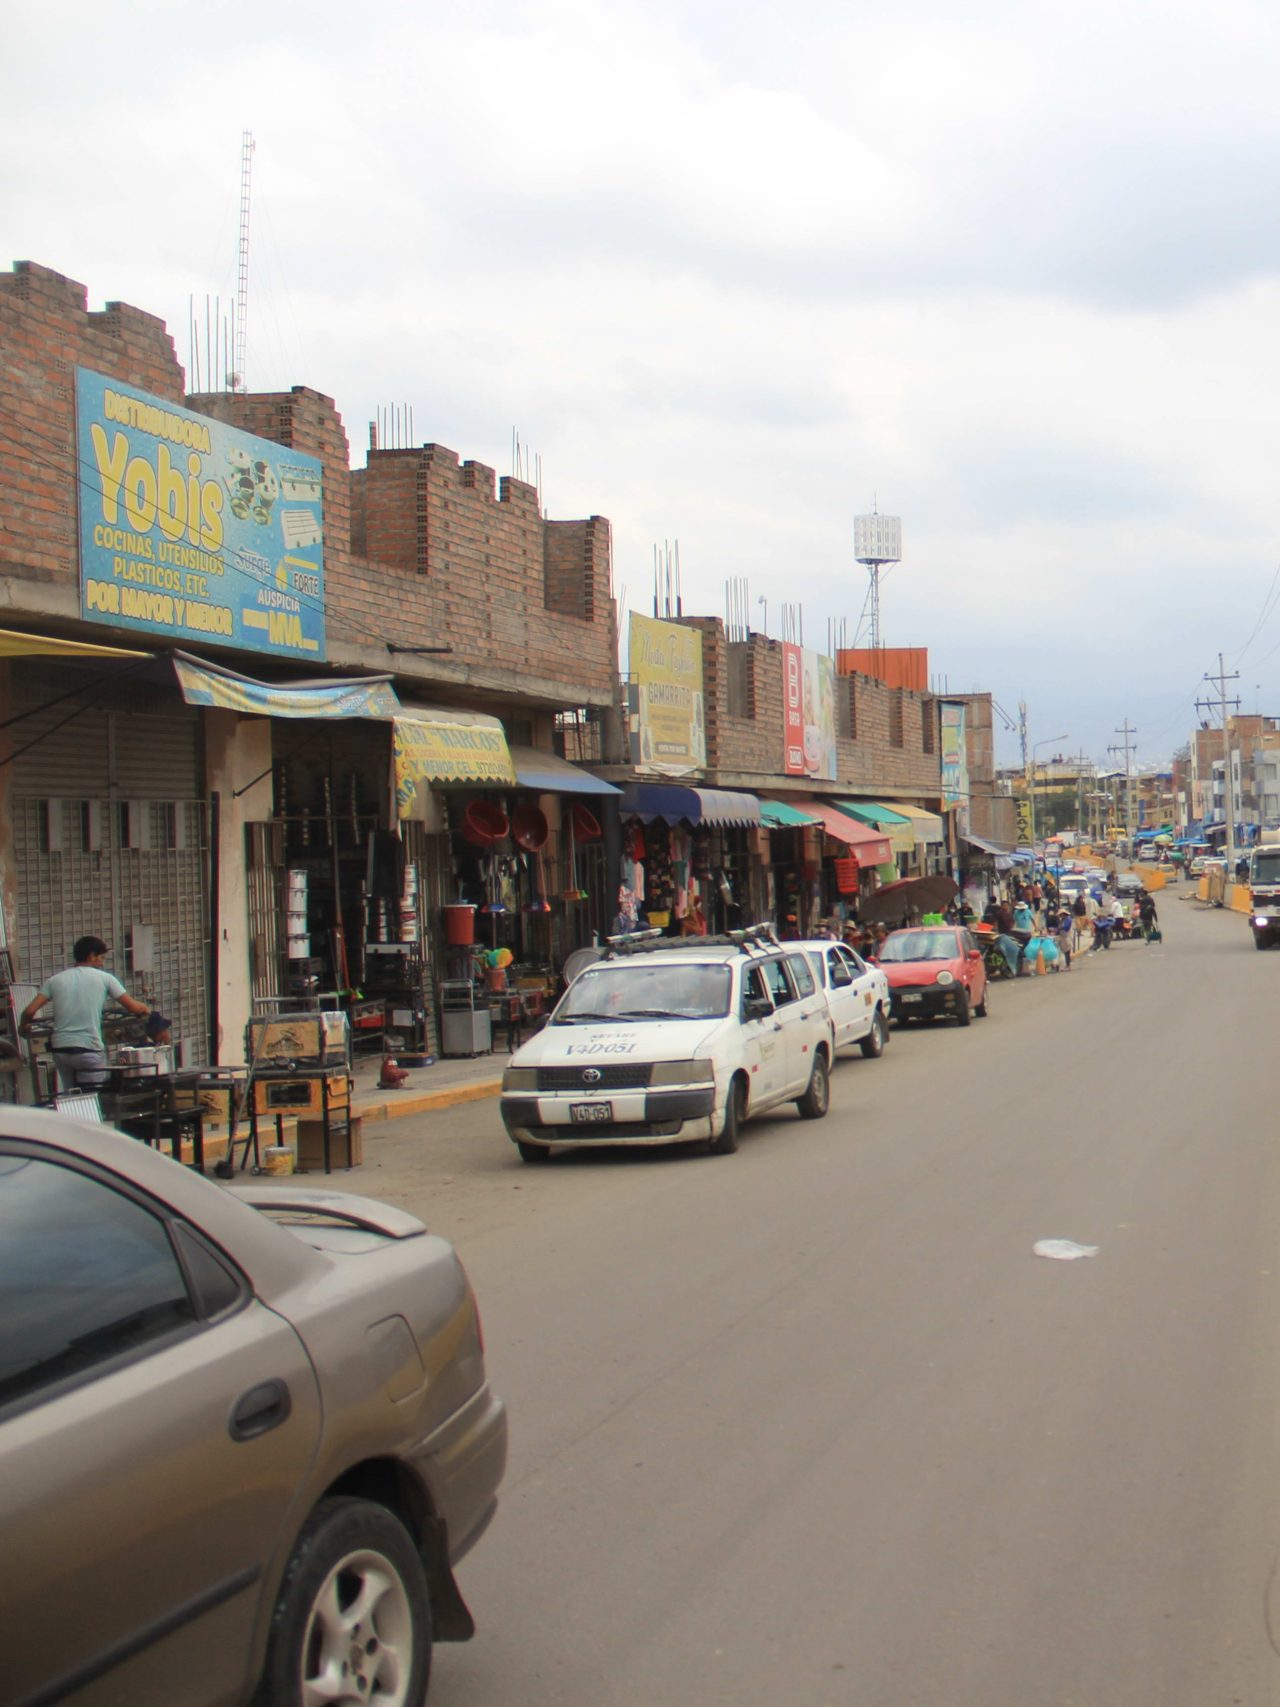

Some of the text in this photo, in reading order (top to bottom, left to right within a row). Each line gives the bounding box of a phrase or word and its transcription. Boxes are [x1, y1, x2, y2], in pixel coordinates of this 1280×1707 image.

[104, 388, 212, 455] DISTRIBUIDORA
[90, 423, 224, 552] Yobis
[94, 524, 224, 576] COCINAS, UTENSILIOS
[113, 556, 210, 598] PLASTICOS, ETC.
[293, 572, 319, 596] FORTE
[87, 578, 233, 636] POR MAYOR Y MENOR
[258, 588, 300, 612] AUSPICIA
[268, 610, 303, 648] MVA
[573, 1105, 611, 1121] V4D-051
